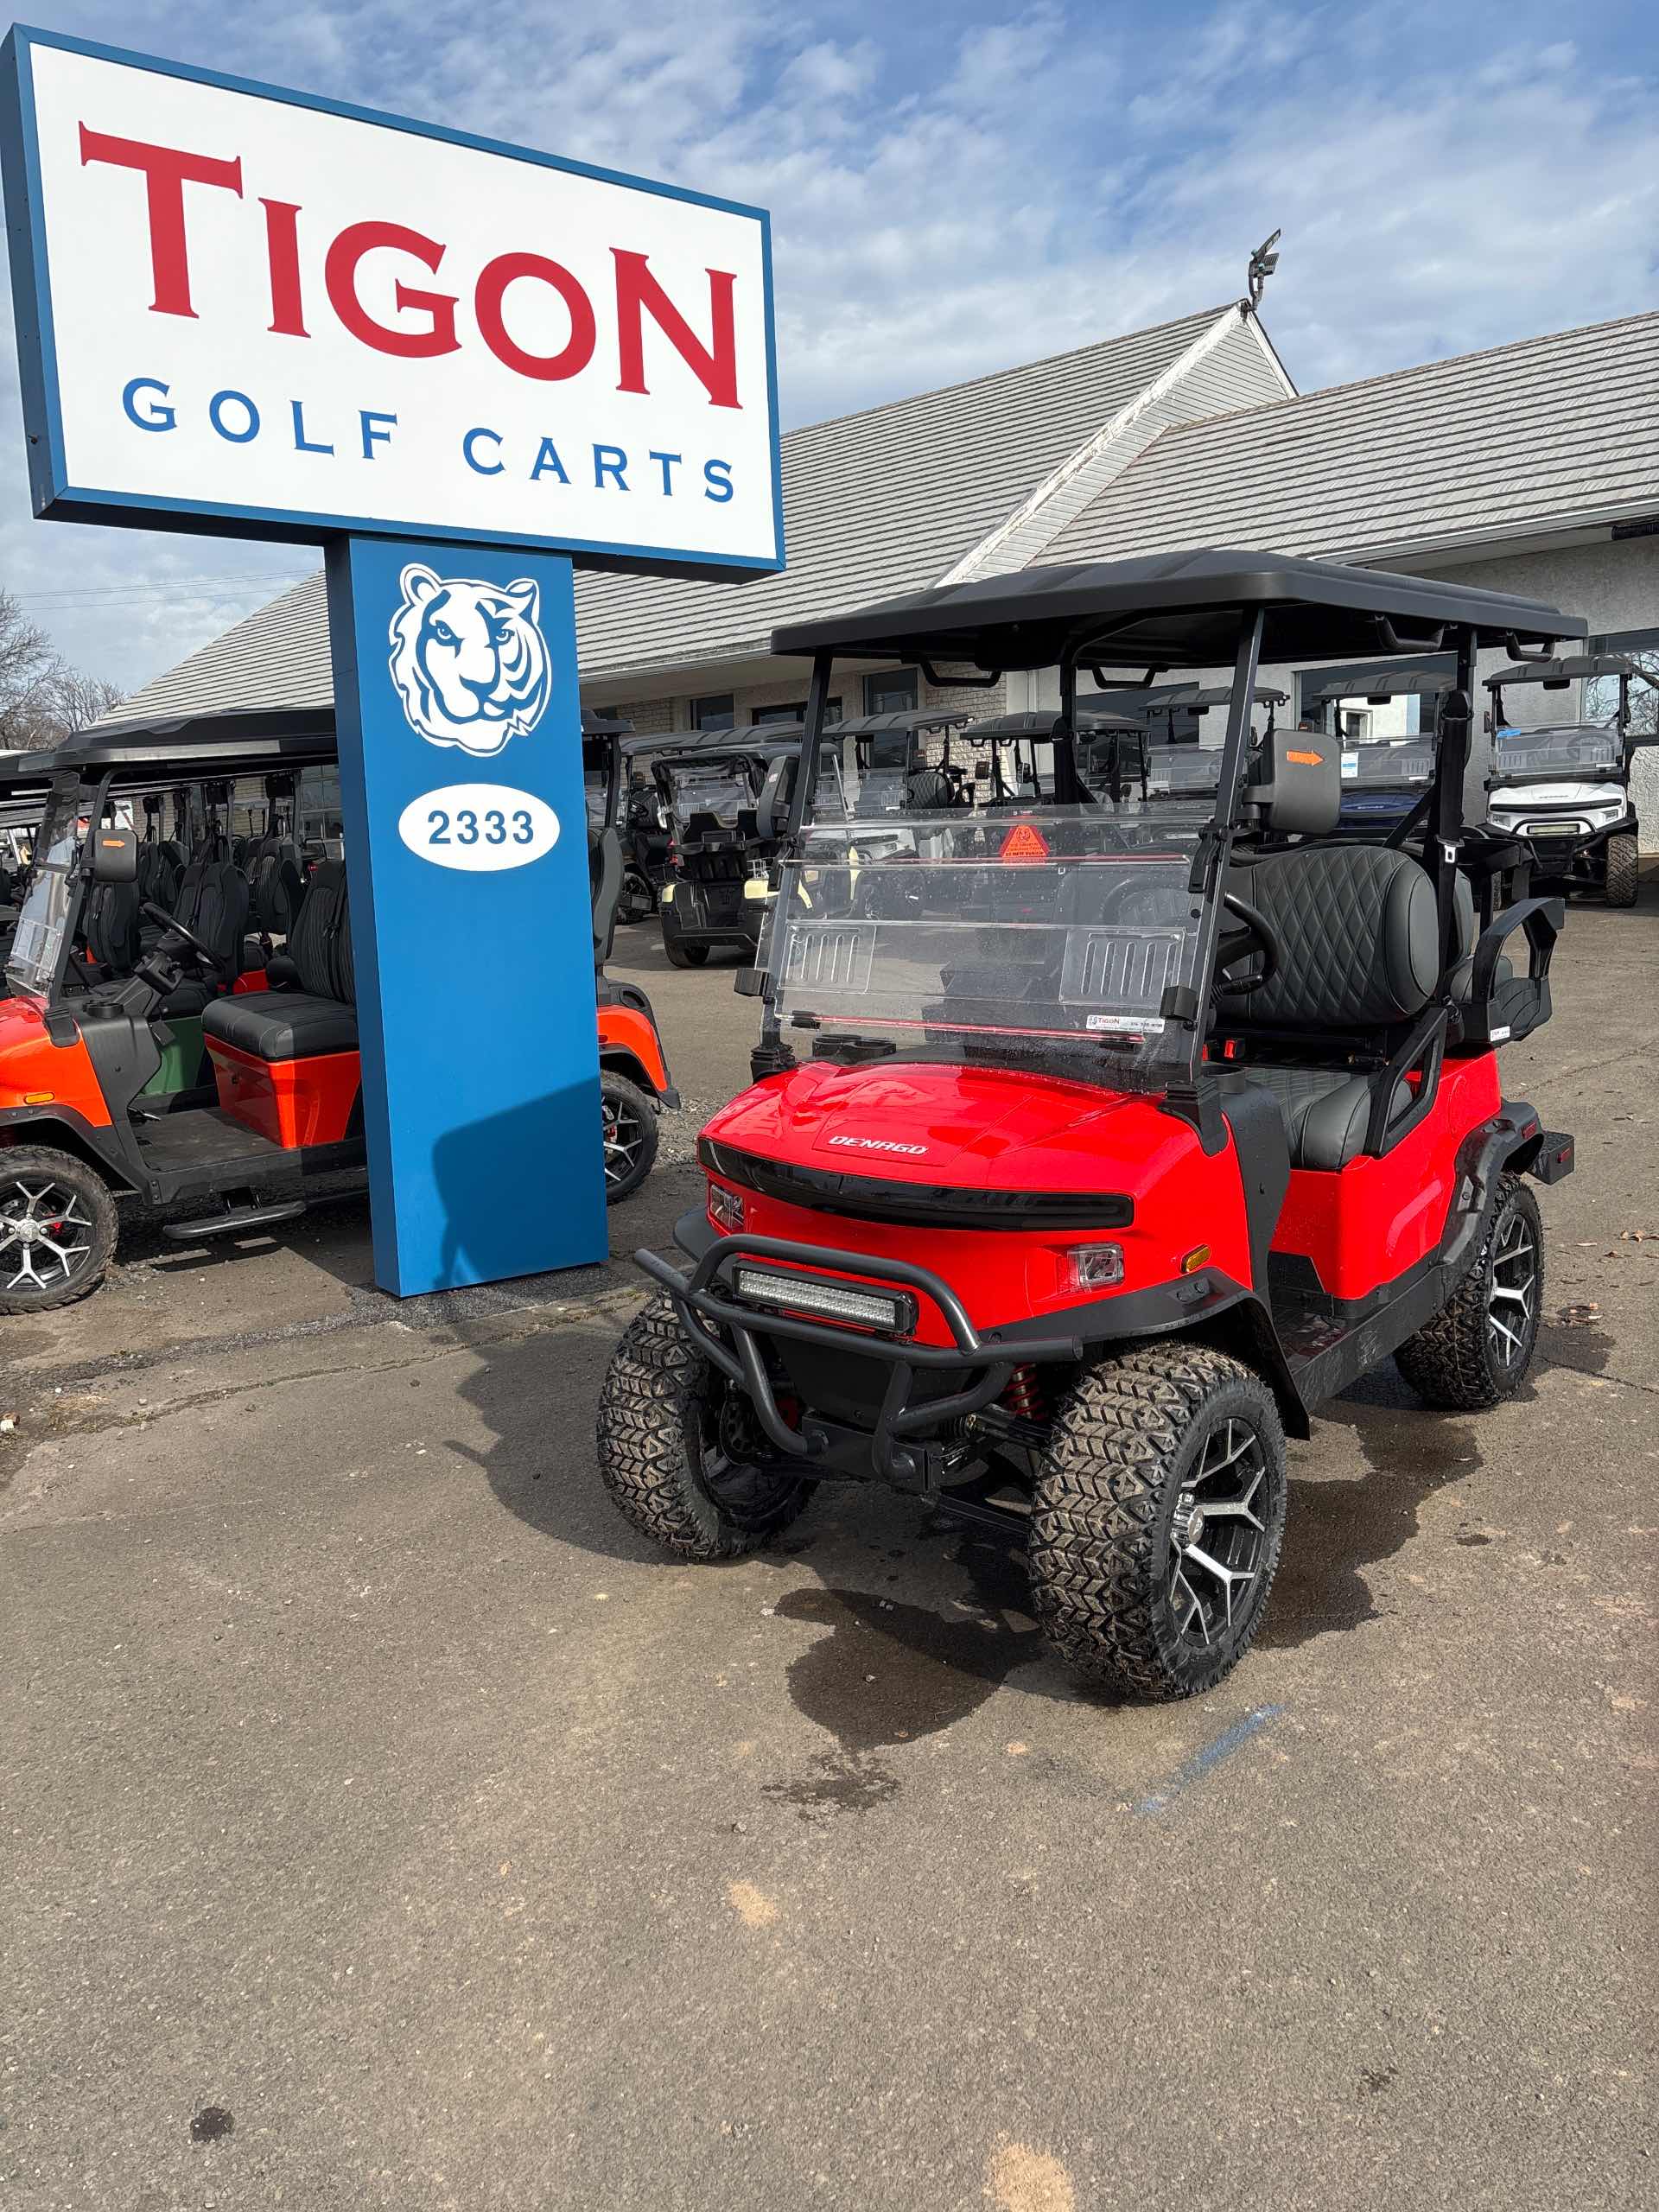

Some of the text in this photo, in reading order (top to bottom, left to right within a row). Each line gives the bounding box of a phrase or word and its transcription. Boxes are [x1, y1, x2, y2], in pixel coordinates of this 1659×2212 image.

[79, 121, 743, 410] TIGON
[122, 377, 735, 504] GOLF CARTS
[427, 810, 534, 845] 2333
[827, 1135, 930, 1155] DENAGO
